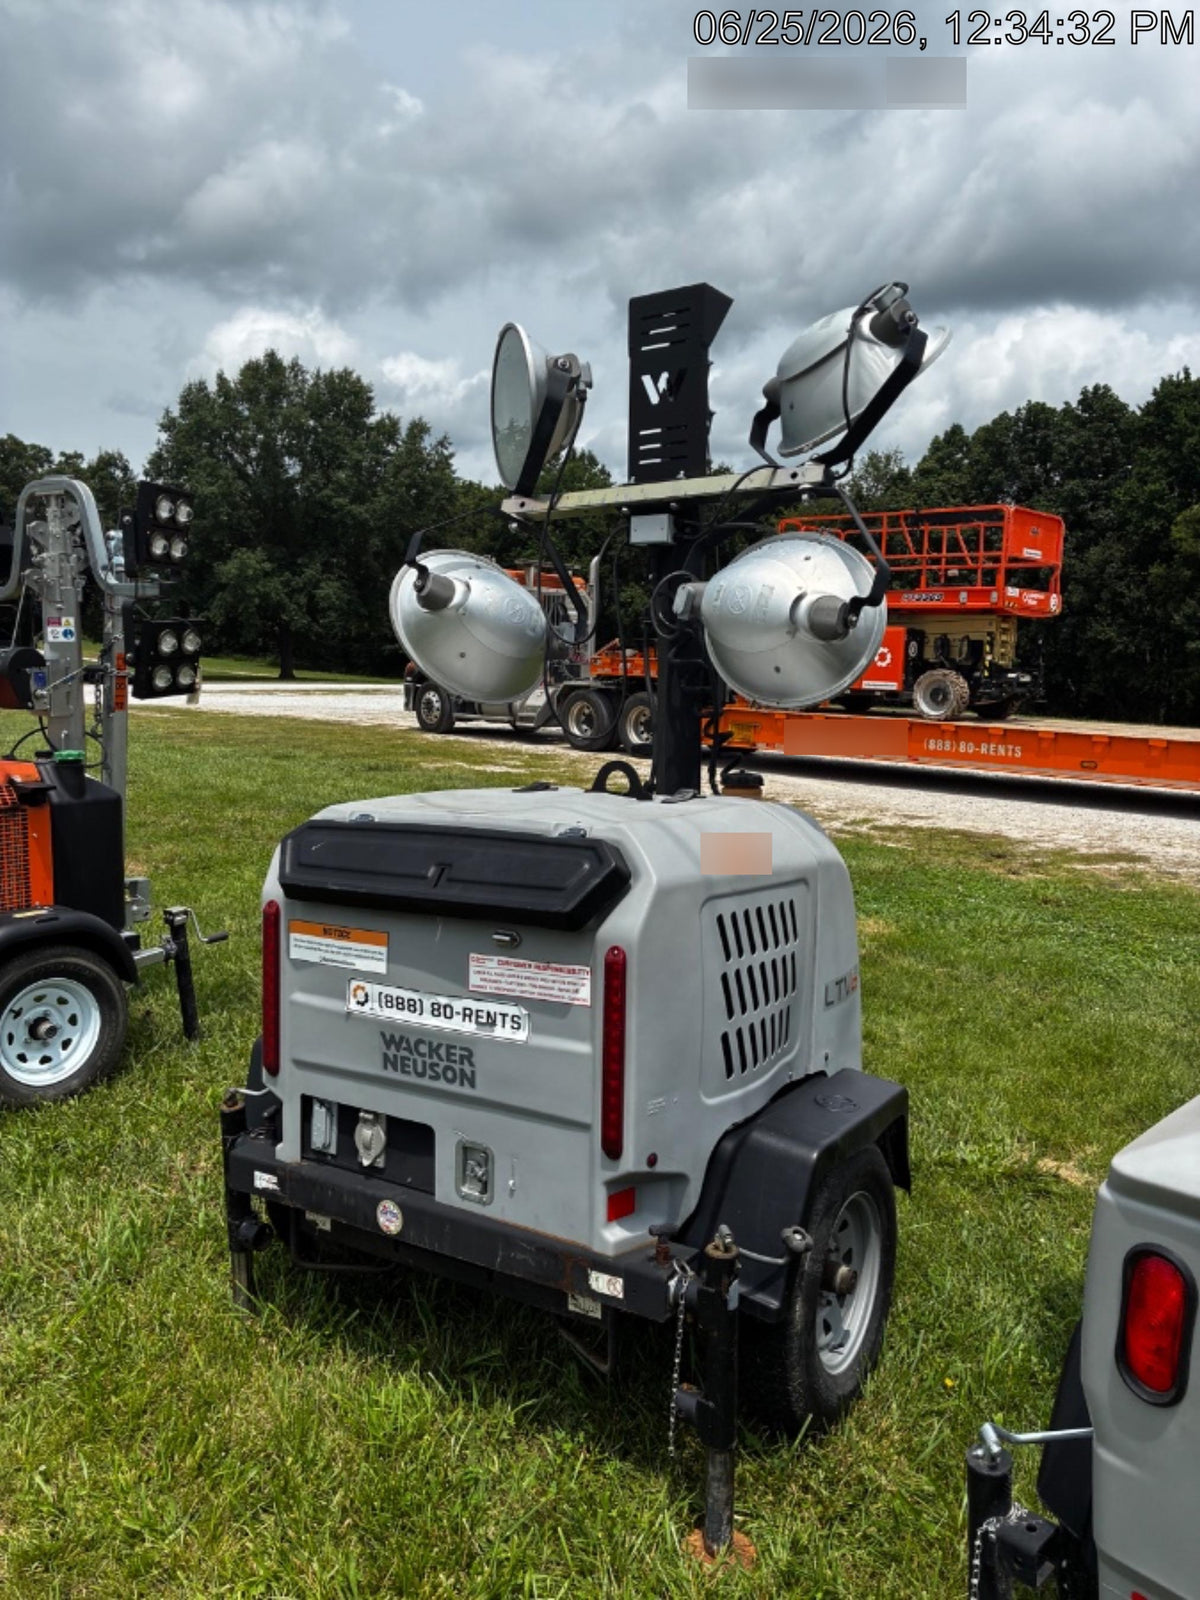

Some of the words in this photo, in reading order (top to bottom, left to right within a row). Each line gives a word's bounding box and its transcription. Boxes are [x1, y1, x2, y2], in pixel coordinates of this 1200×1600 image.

[923, 738, 956, 752] (888)
[959, 741, 1022, 758] 80-RENTS
[378, 991, 424, 1016] (888)
[431, 1002, 522, 1031] 80-RENTS
[380, 1031, 476, 1068] WACKER
[382, 1052, 476, 1089] NEUSON
